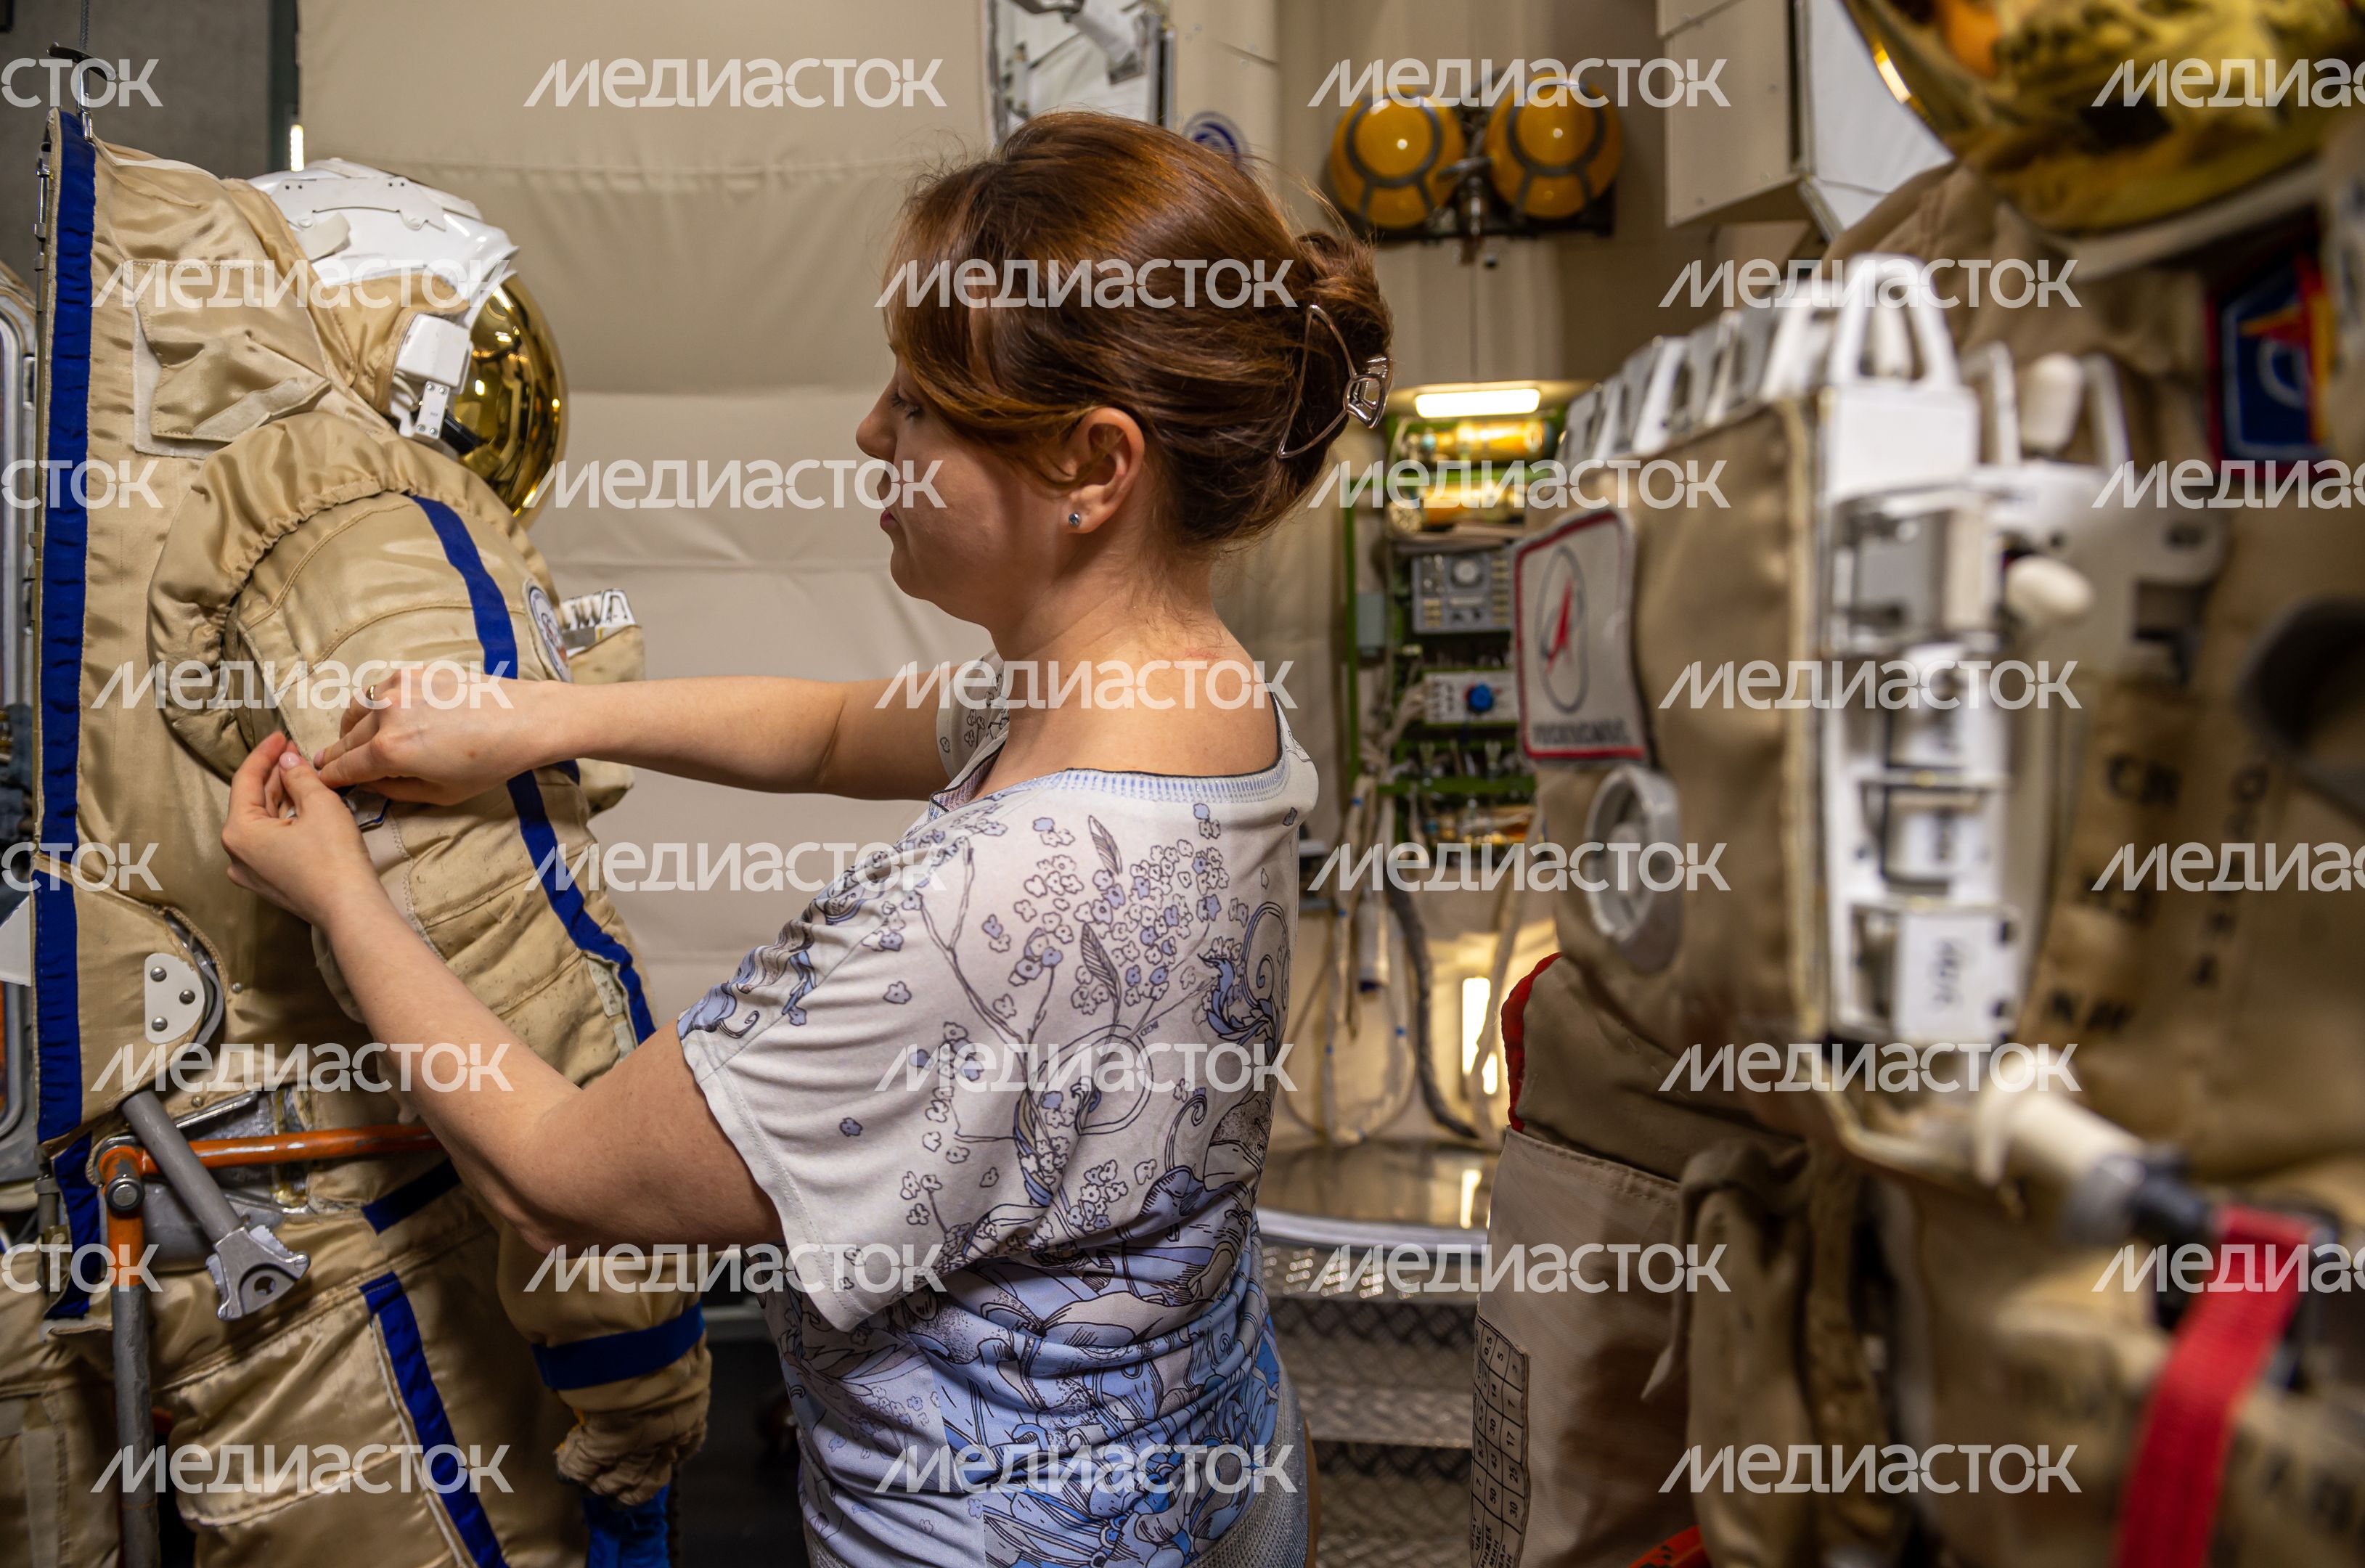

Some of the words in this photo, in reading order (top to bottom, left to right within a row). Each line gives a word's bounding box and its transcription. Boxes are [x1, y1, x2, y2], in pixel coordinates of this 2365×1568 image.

[1498, 1351, 1504, 1361] 5
[1491, 1383, 1498, 1398] 14
[1490, 1418, 1496, 1435] 30
[1506, 1431, 1515, 1447] 17
[1491, 1453, 1498, 1469] 43
[1476, 1477, 1482, 1487] 7
[1509, 1465, 1519, 1484] 25
[1490, 1488, 1497, 1504] 50
[1510, 1501, 1519, 1518] 30
[1480, 1525, 1492, 1568] ИНЖЕК
[1489, 1540, 1499, 1568] МИН
